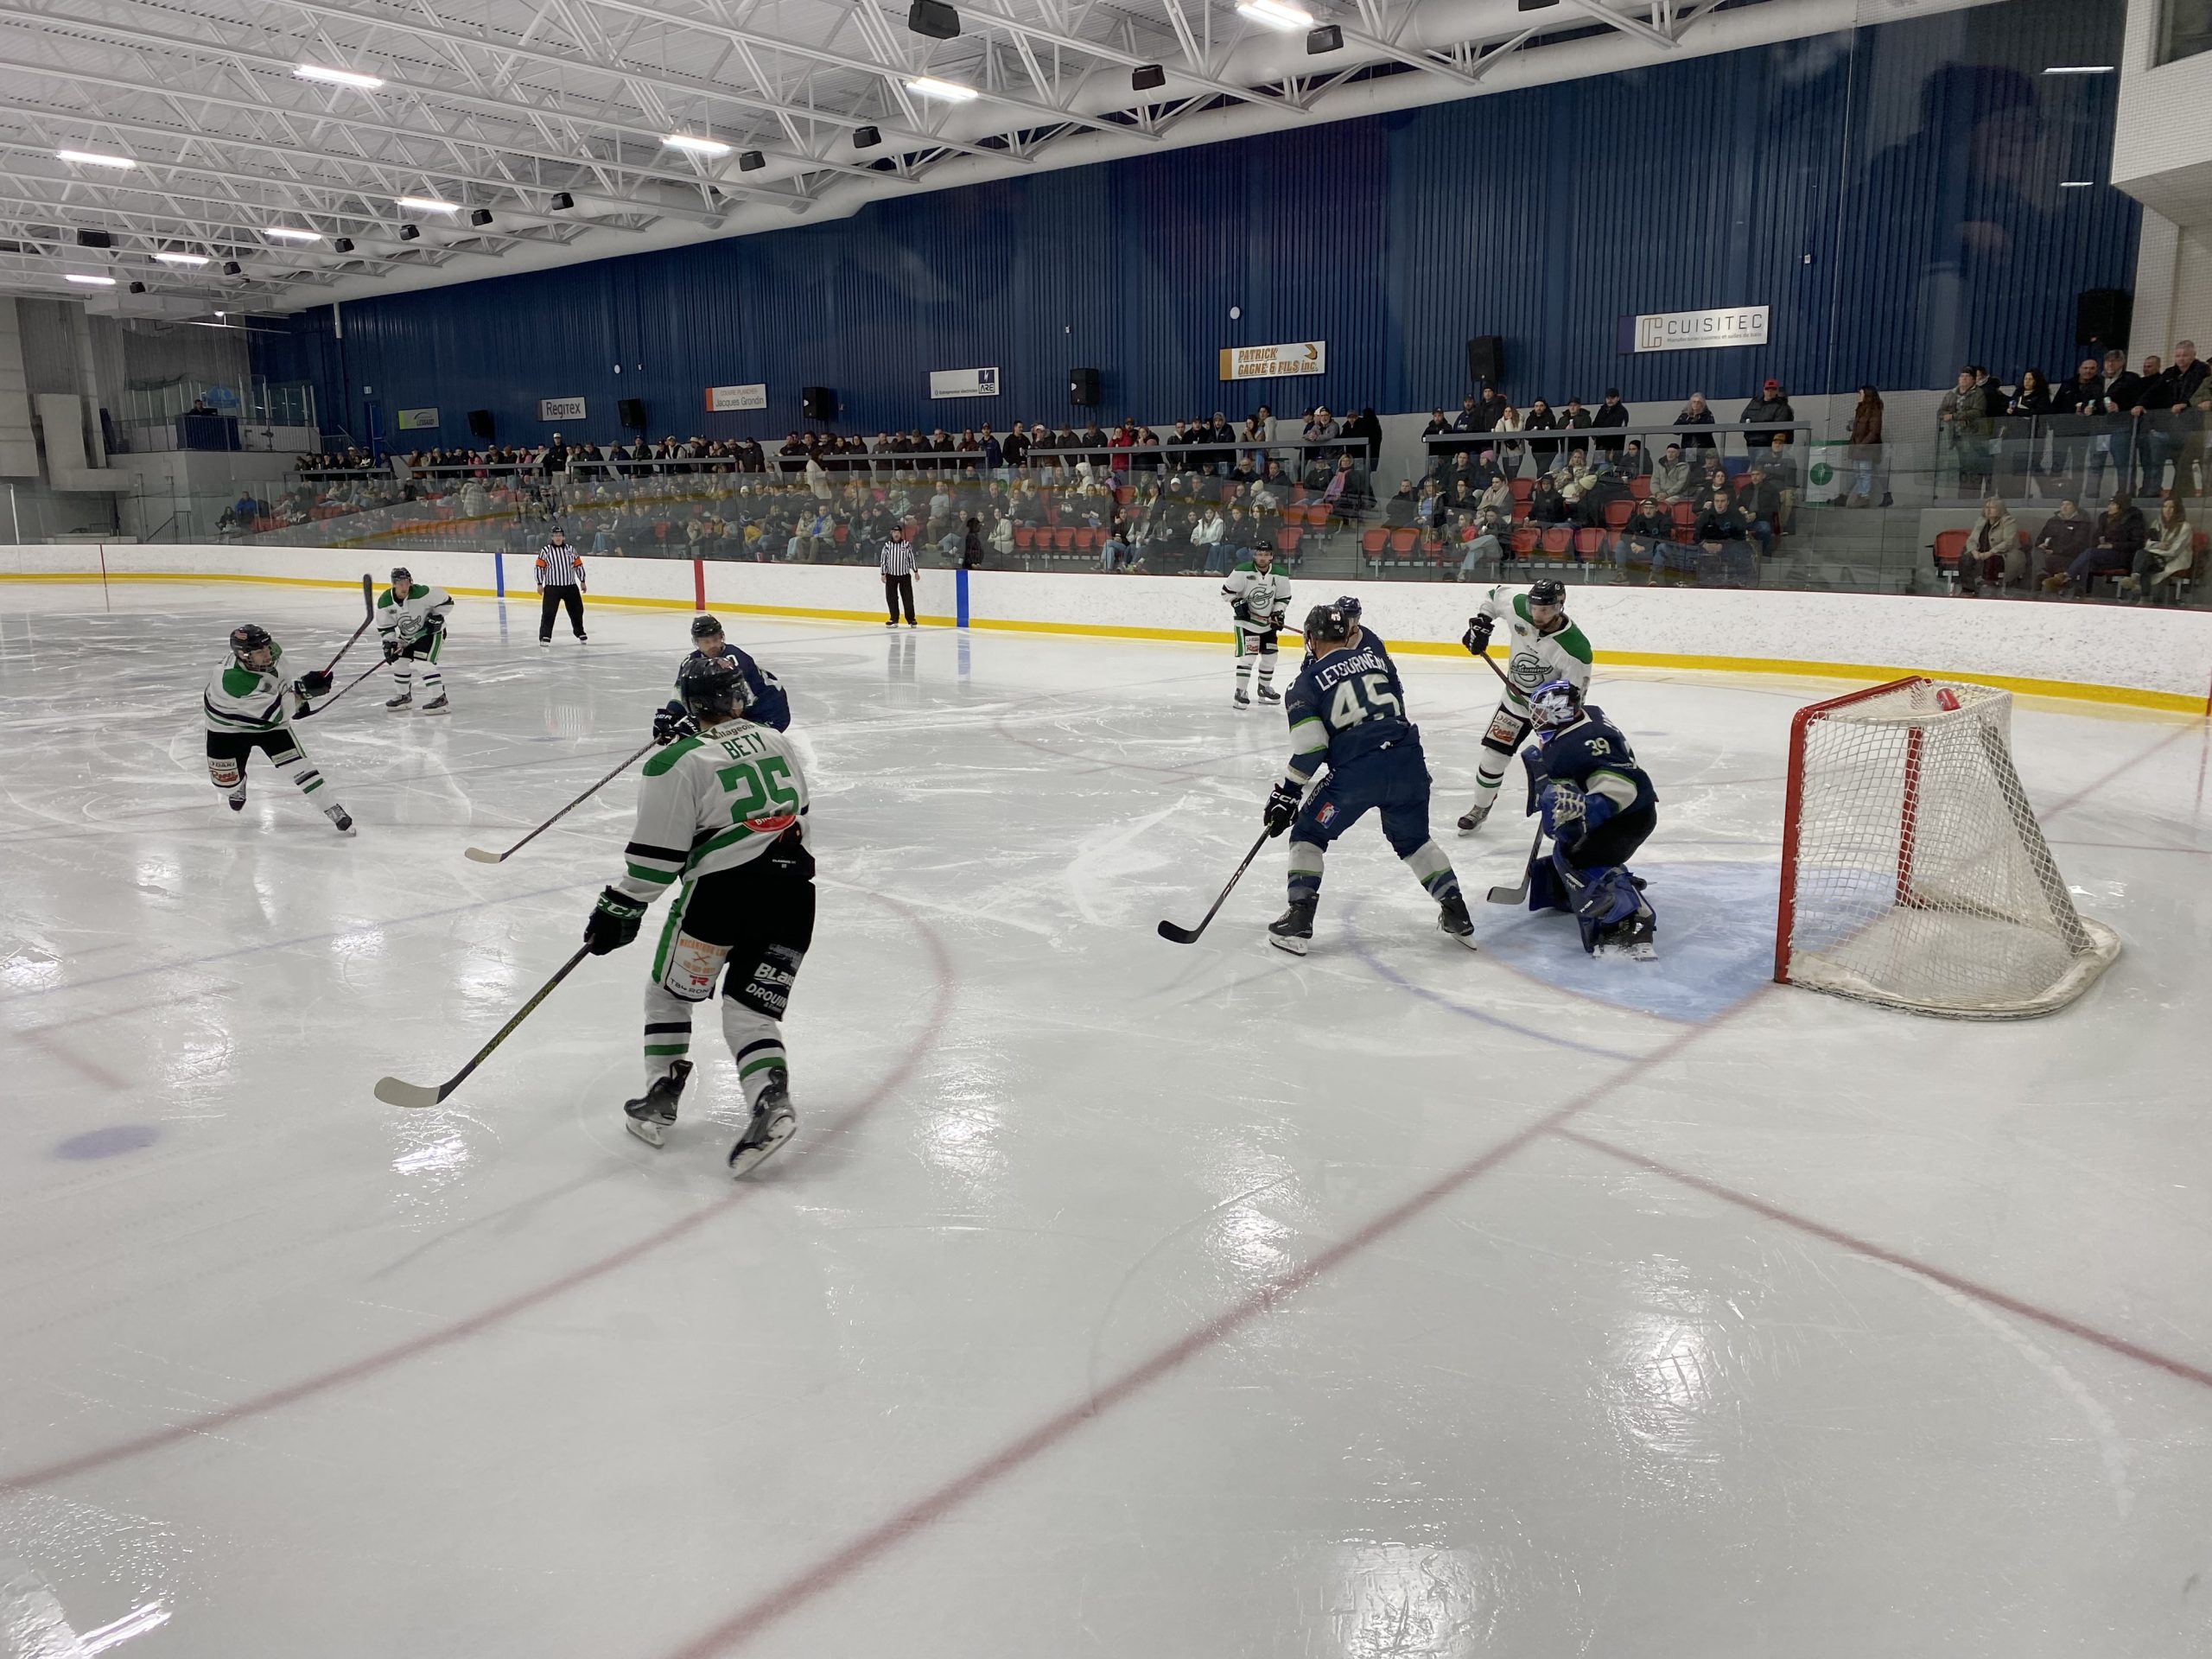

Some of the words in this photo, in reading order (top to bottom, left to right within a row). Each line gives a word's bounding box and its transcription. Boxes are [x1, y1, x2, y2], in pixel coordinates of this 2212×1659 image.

[1669, 314, 1763, 334] CUISITEC
[1239, 347, 1277, 362] PATRICK
[1279, 360, 1300, 374] FILS
[1301, 359, 1319, 372] inc.
[716, 398, 740, 408] Jacques
[741, 396, 764, 406] Grondin
[1271, 576, 1277, 587] A
[1330, 673, 1402, 730] 45
[720, 731, 766, 760] BETY
[1584, 737, 1611, 757] 39
[715, 755, 799, 823] 25
[1271, 791, 1300, 806] CCM
[746, 982, 787, 1008] DROUIN
